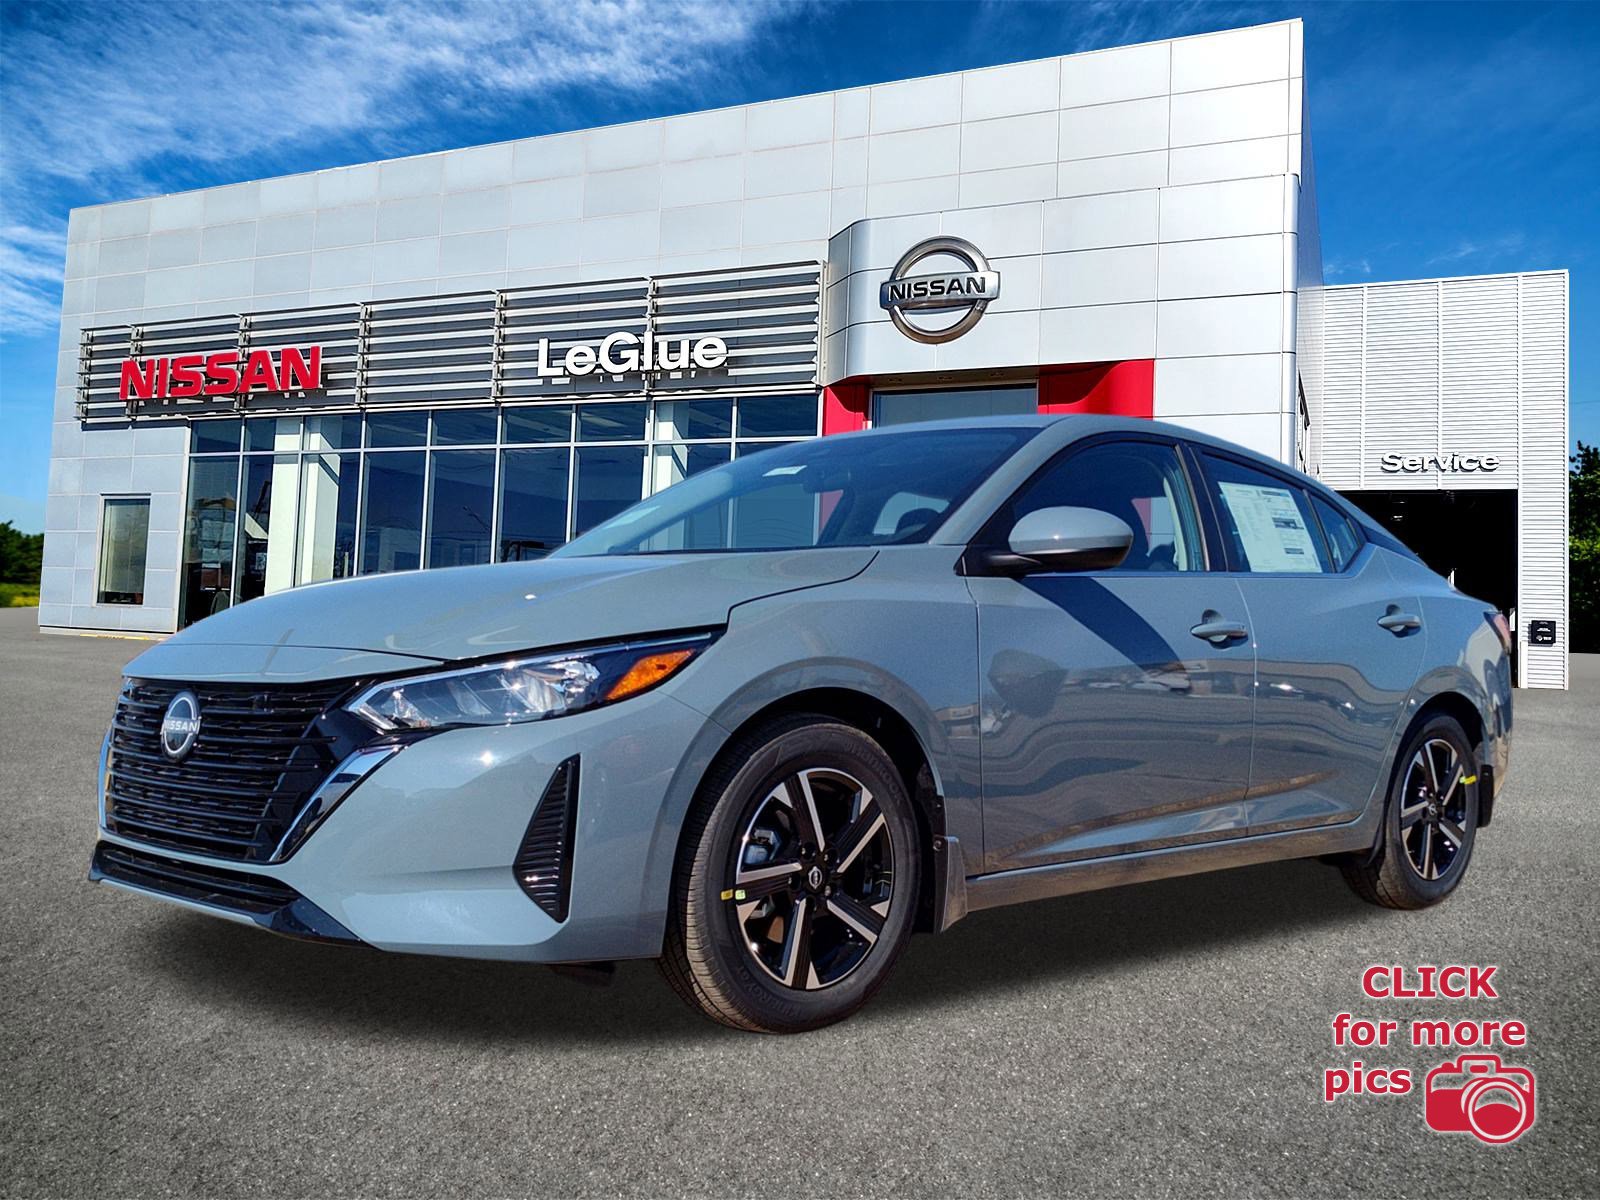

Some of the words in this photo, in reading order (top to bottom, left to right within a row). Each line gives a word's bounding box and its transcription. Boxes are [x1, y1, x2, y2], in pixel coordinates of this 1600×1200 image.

[889, 276, 985, 301] NISSAN
[537, 331, 728, 377] LeGlue
[119, 345, 322, 401] NISSAN
[1381, 450, 1500, 473] Service
